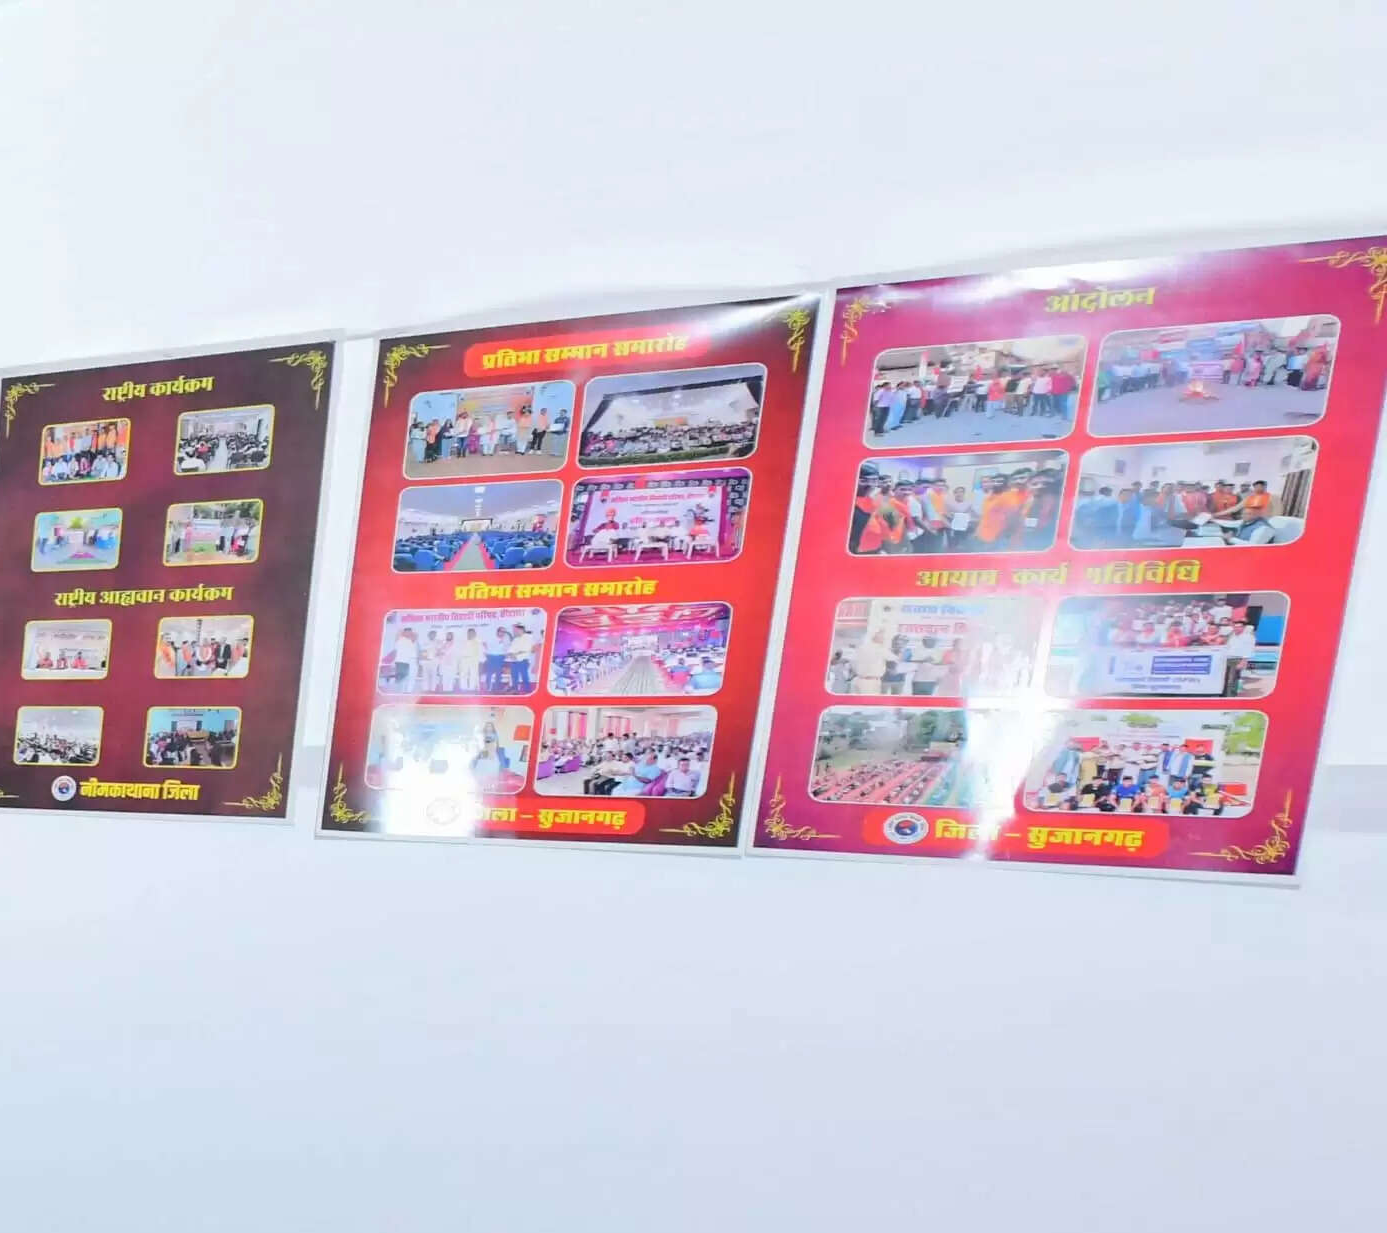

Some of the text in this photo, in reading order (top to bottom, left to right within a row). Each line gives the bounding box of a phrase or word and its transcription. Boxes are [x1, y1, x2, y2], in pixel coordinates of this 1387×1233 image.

[1045, 286, 1156, 313] आंदोलन
[543, 343, 609, 364] सम्मान
[102, 380, 146, 403] राष्ट्रीय
[53, 588, 96, 609] राष्ट्रीय
[516, 582, 578, 600] सम्मान
[582, 576, 659, 598] समारोह
[79, 777, 201, 802] नीमकाथाना जिला
[537, 808, 629, 831] सुजानगढ़
[1027, 826, 1145, 853] सुजानगढ़
